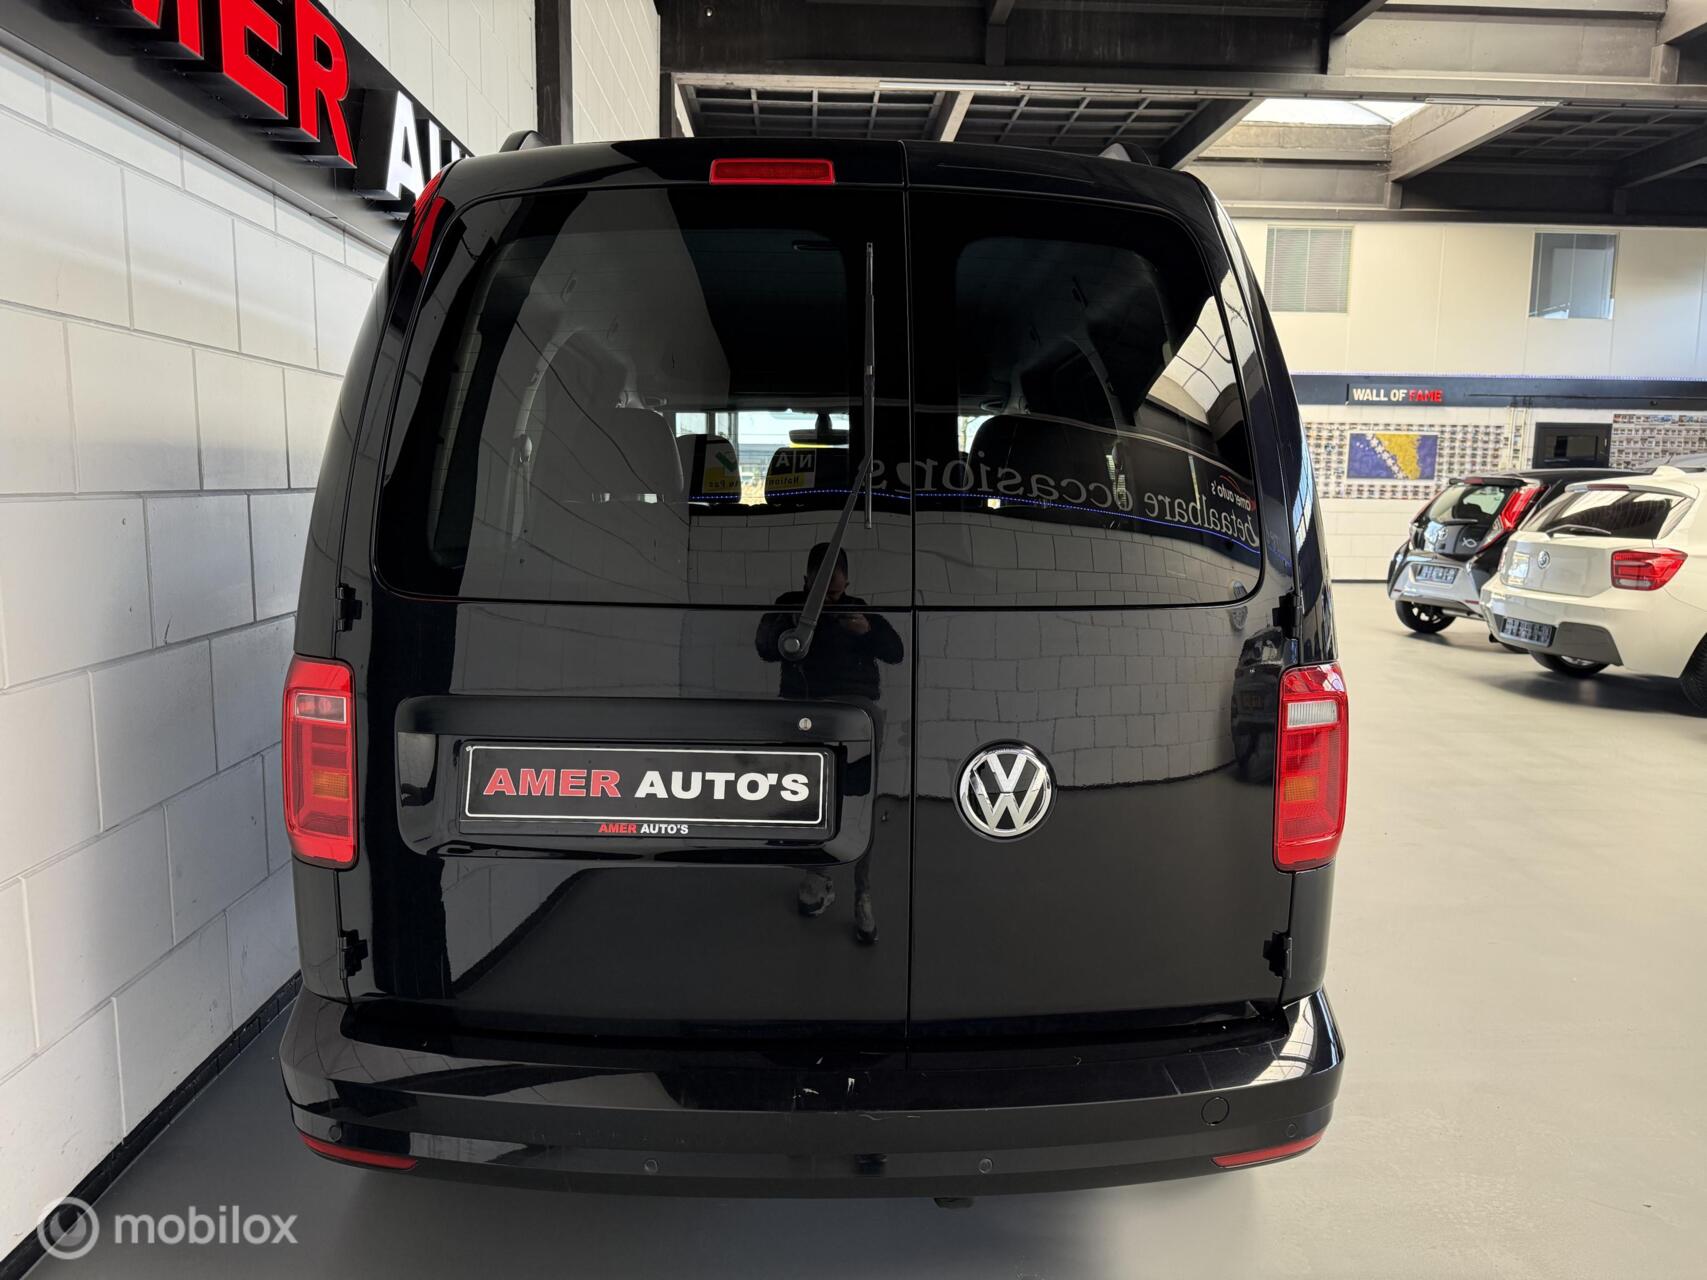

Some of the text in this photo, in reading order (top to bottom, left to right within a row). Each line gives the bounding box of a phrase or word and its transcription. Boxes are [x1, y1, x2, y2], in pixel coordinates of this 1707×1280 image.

[131, 0, 357, 168] ER
[1352, 388, 1444, 403] WALL OF FAME
[483, 768, 810, 802] AMER AUTO'S
[598, 823, 689, 835] AMER AUTO'S
